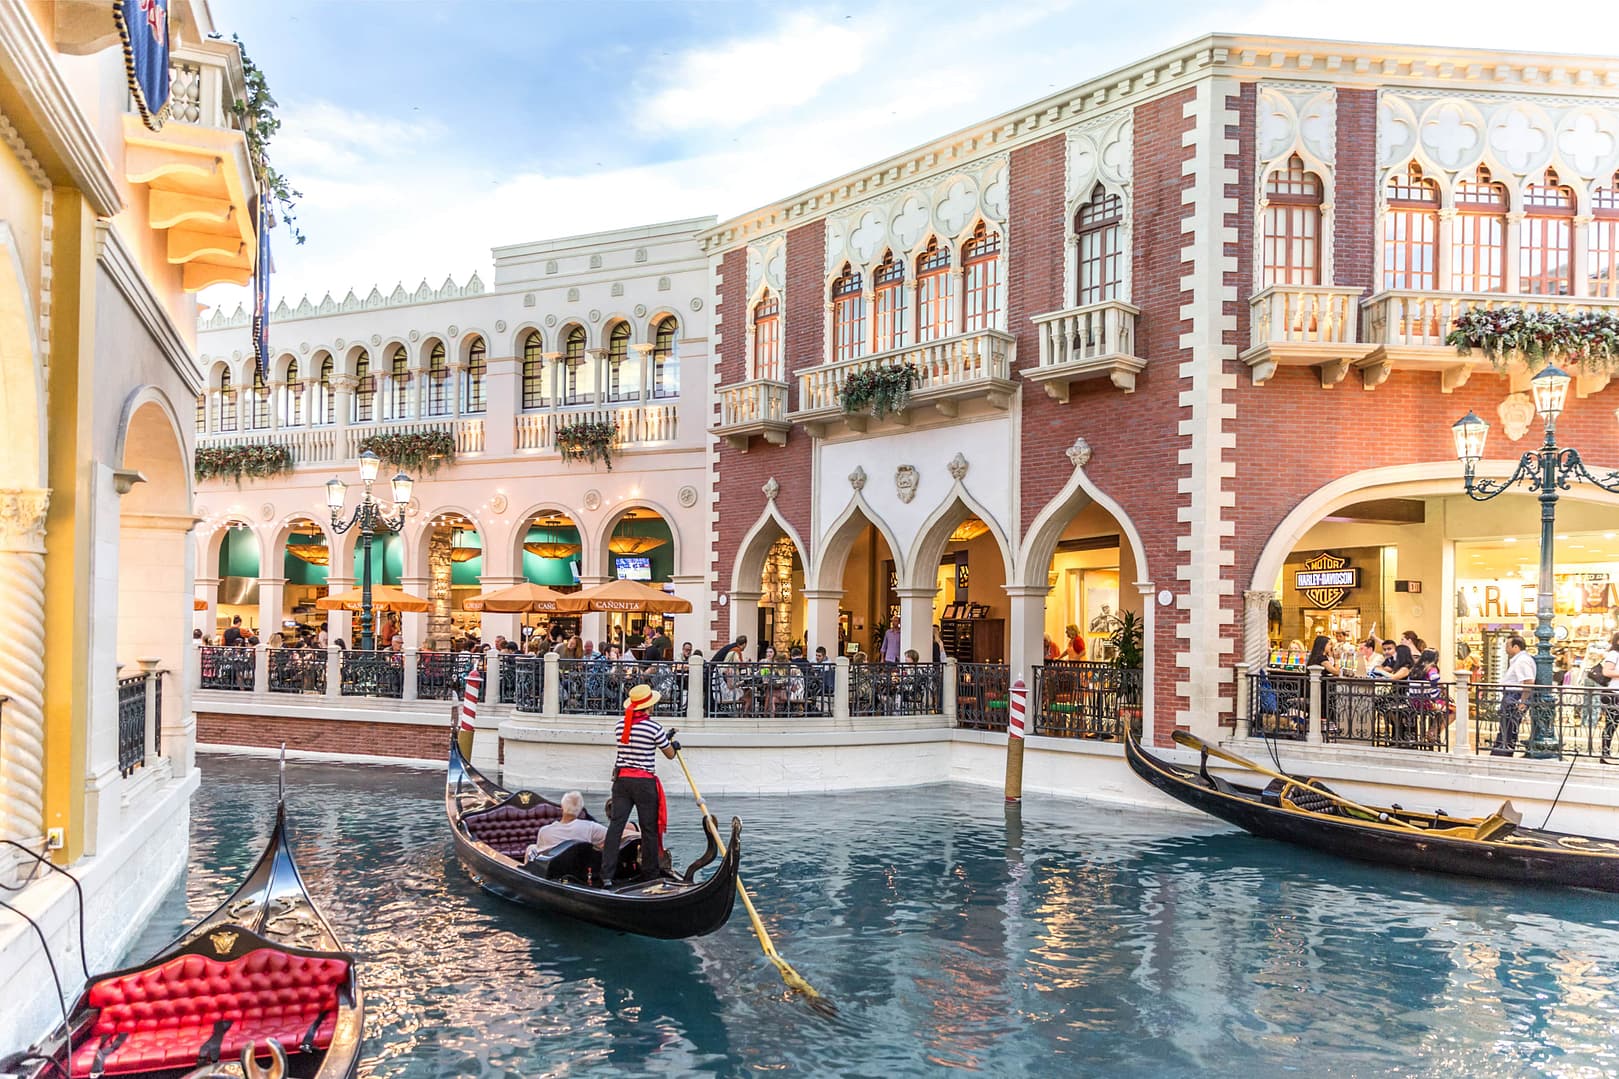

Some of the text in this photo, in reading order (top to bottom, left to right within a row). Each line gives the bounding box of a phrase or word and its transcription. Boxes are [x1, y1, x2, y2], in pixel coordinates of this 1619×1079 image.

[1311, 559, 1340, 570] MOTOR
[1297, 572, 1353, 586] HARLEY-DAVIDSON
[1310, 588, 1341, 605] CYCLES
